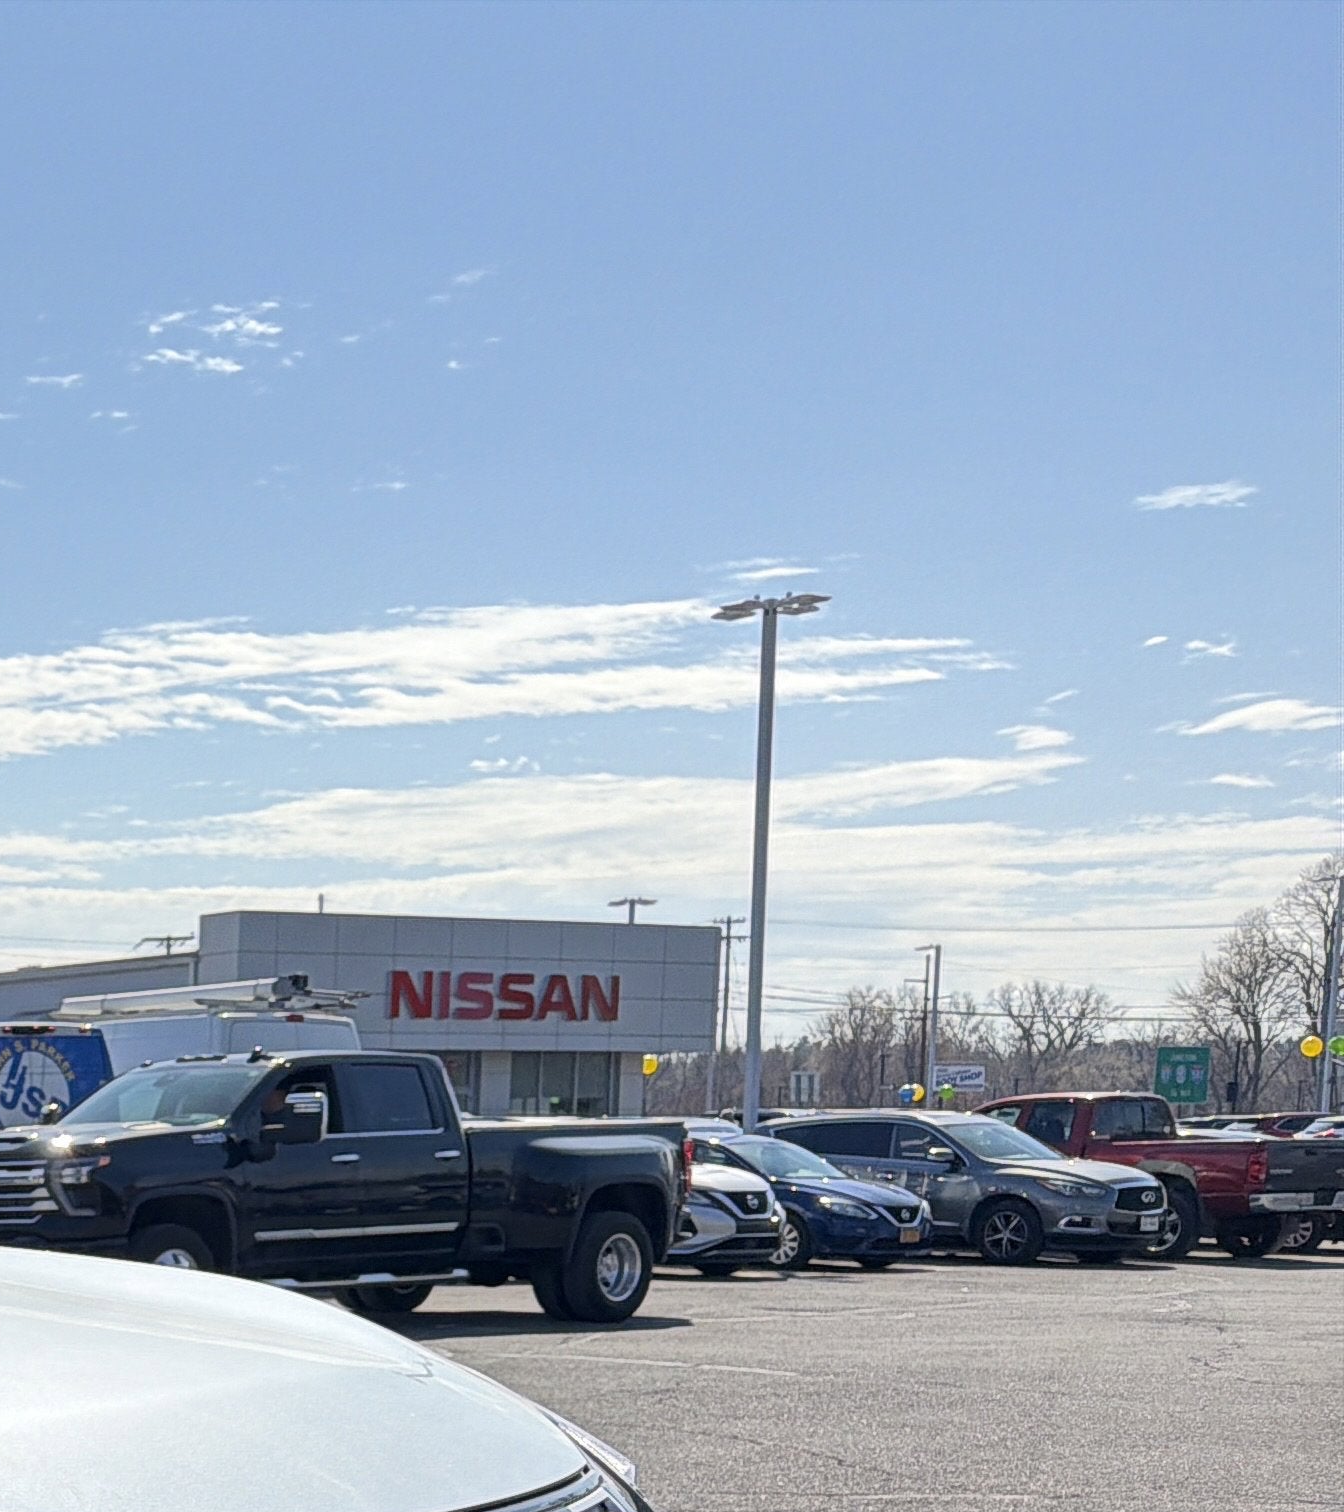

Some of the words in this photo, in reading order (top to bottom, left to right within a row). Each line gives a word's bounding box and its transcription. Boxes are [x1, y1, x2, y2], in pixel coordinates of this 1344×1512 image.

[388, 970, 620, 1022] NISSAN
[31, 1039, 75, 1081] PARKER
[959, 1071, 983, 1082] SHOP
